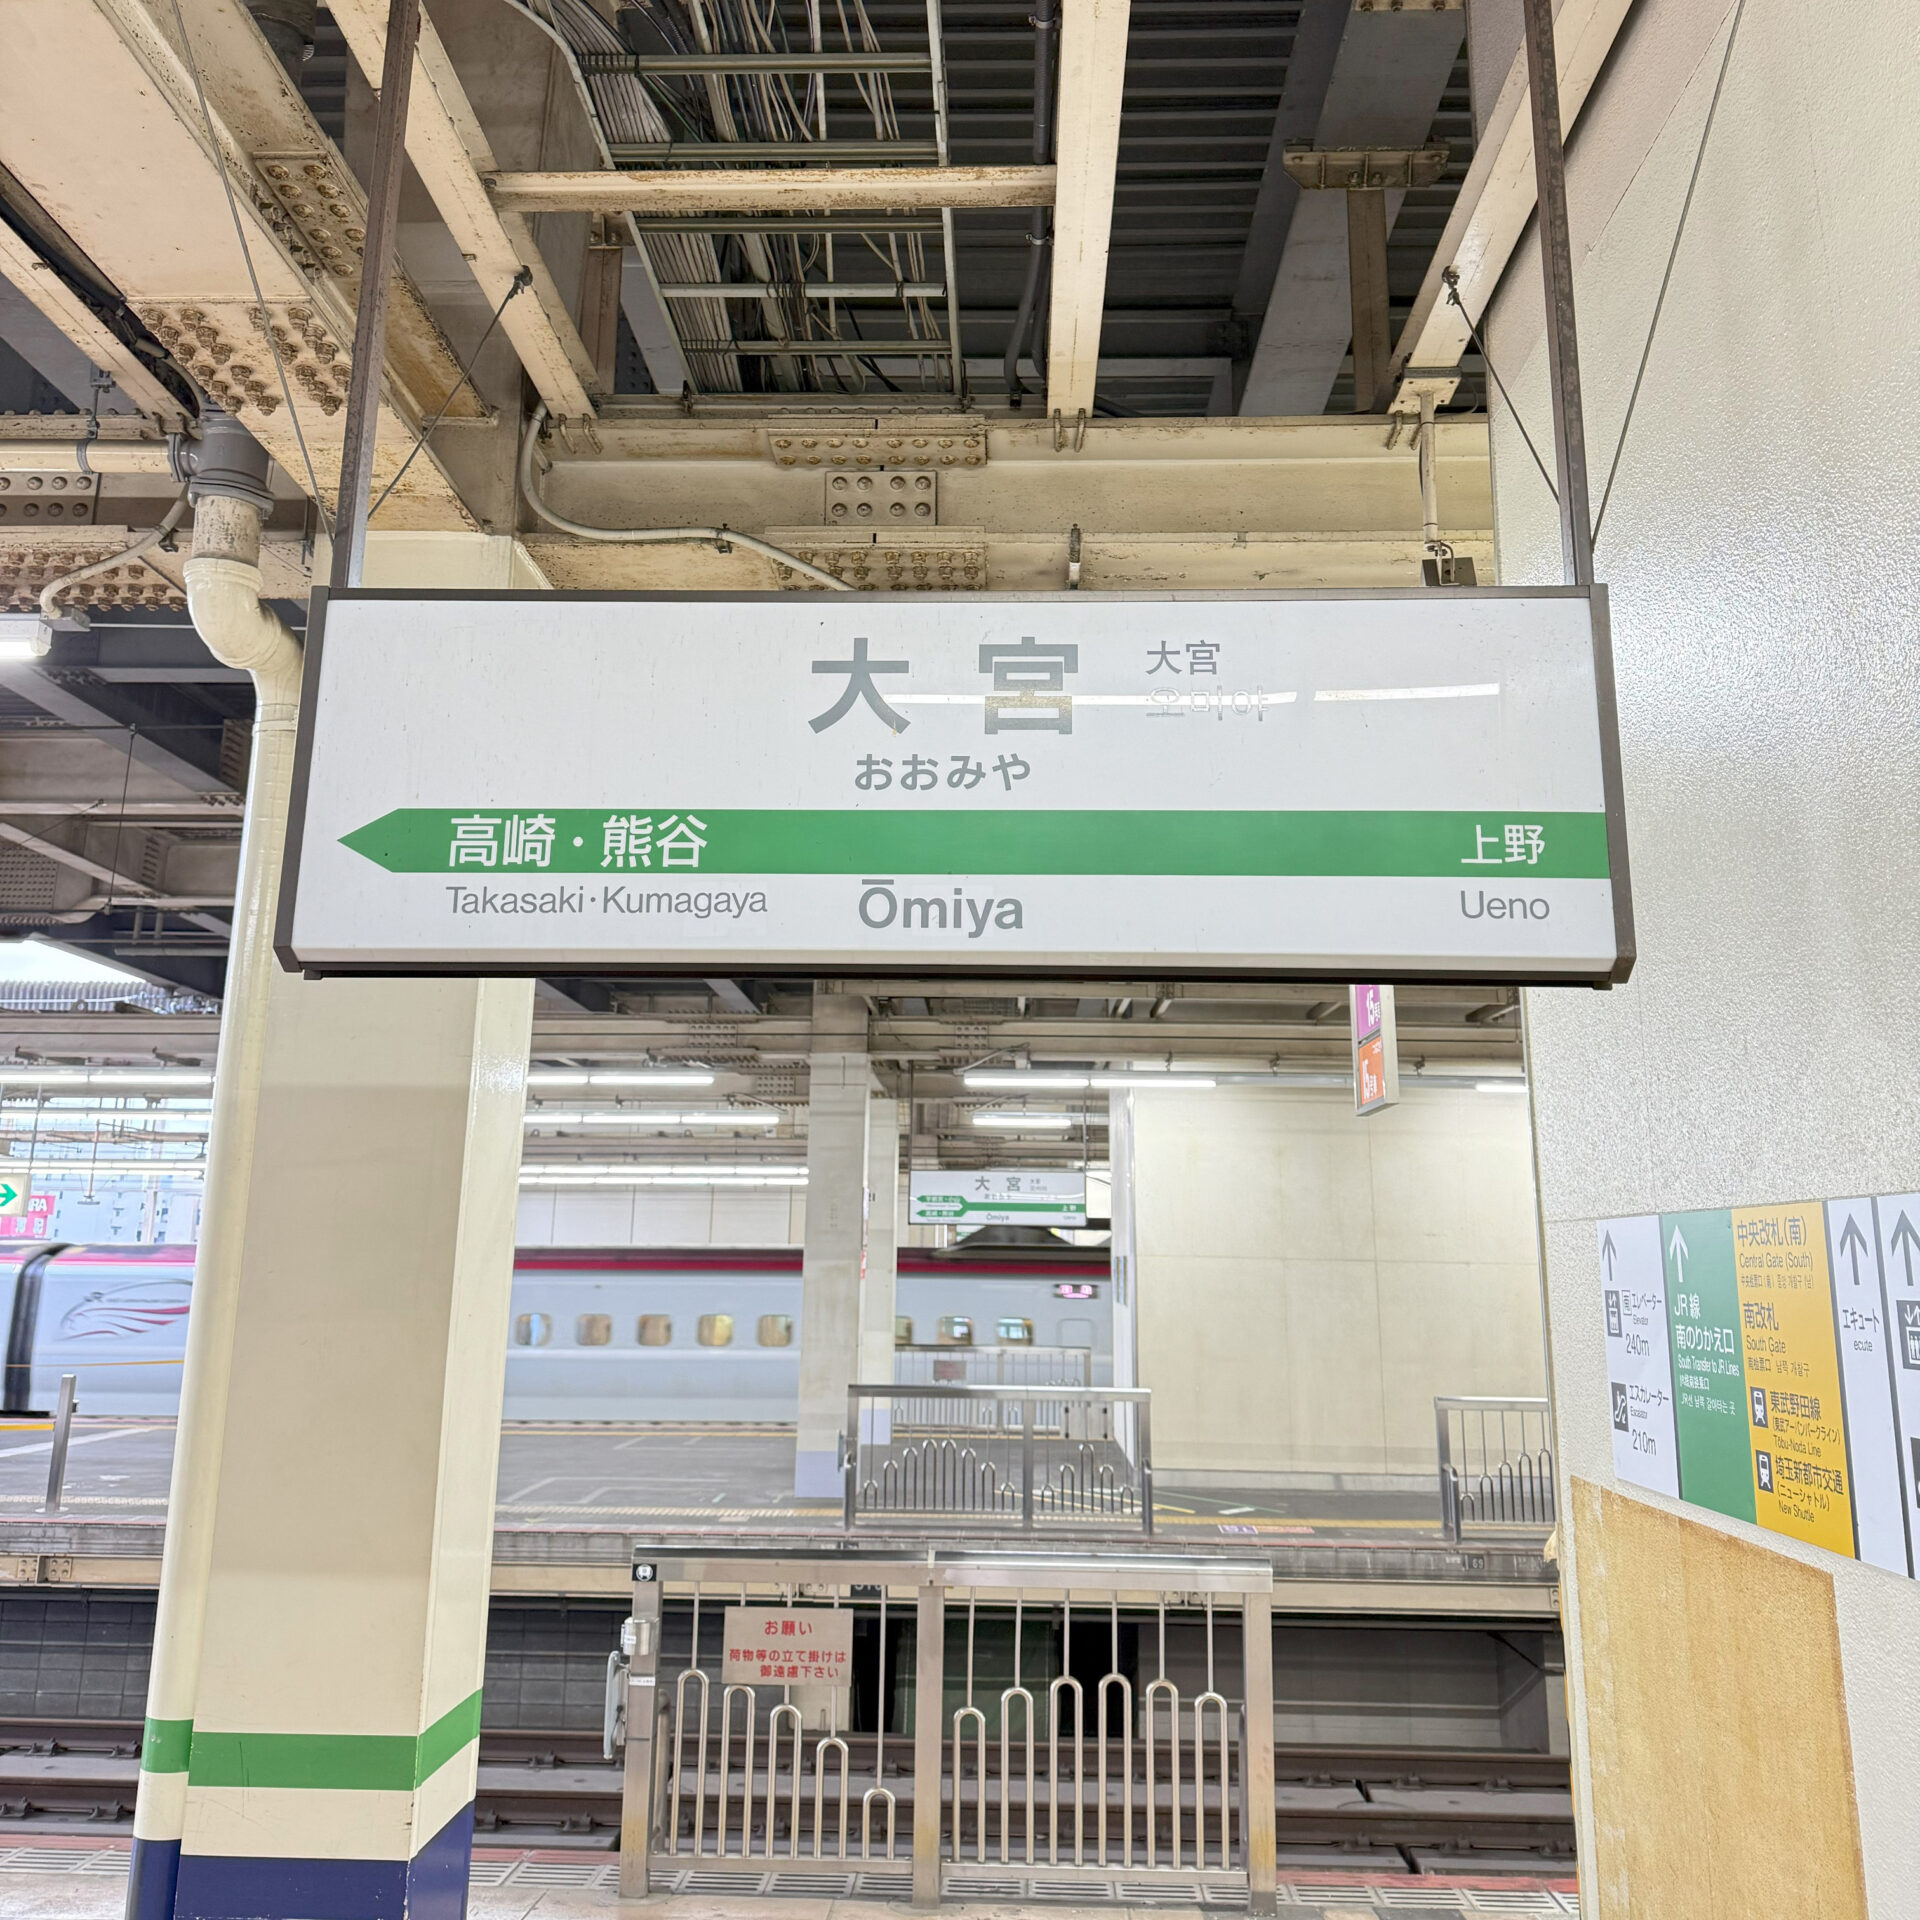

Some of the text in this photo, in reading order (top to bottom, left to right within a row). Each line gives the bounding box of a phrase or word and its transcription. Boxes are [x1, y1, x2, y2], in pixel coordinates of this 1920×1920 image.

[808, 636, 1079, 736] 大宮
[1145, 685, 1270, 722] 오미야
[854, 752, 1032, 792] おおみや
[447, 813, 709, 869] 高崎・熊谷
[1460, 824, 1545, 866] 上野
[858, 878, 1024, 938] Ōmiya
[1459, 890, 1551, 921] Ueno
[975, 1175, 1021, 1192] 大宮
[1739, 1251, 1814, 1272] Central Gate (South)
[1632, 1293, 1663, 1311] エレベーター
[1743, 1300, 1779, 1331] 南改札
[1842, 1307, 1880, 1333] エキュート
[1625, 1333, 1650, 1357] 240m
[1675, 1324, 1735, 1355] 南のりかえ口
[1746, 1334, 1787, 1354] South Gate
[1853, 1340, 1873, 1352] ecute
[1677, 1353, 1740, 1377] South Transfer to JR Lines
[1629, 1384, 1669, 1407] エスカレーター
[1769, 1390, 1822, 1421] 東武野田線
[1632, 1429, 1657, 1456] 210m
[1807, 1442, 1822, 1458] Line
[1775, 1455, 1844, 1495] 埼玉新都市交通
[1777, 1481, 1830, 1511] (ニューシャトル)
[1778, 1500, 1815, 1523] New Shuttle
[764, 1620, 813, 1637] お願い
[729, 1648, 847, 1663] 荷物等の立て掛けは
[759, 1664, 840, 1679] 御遠慮下さい
